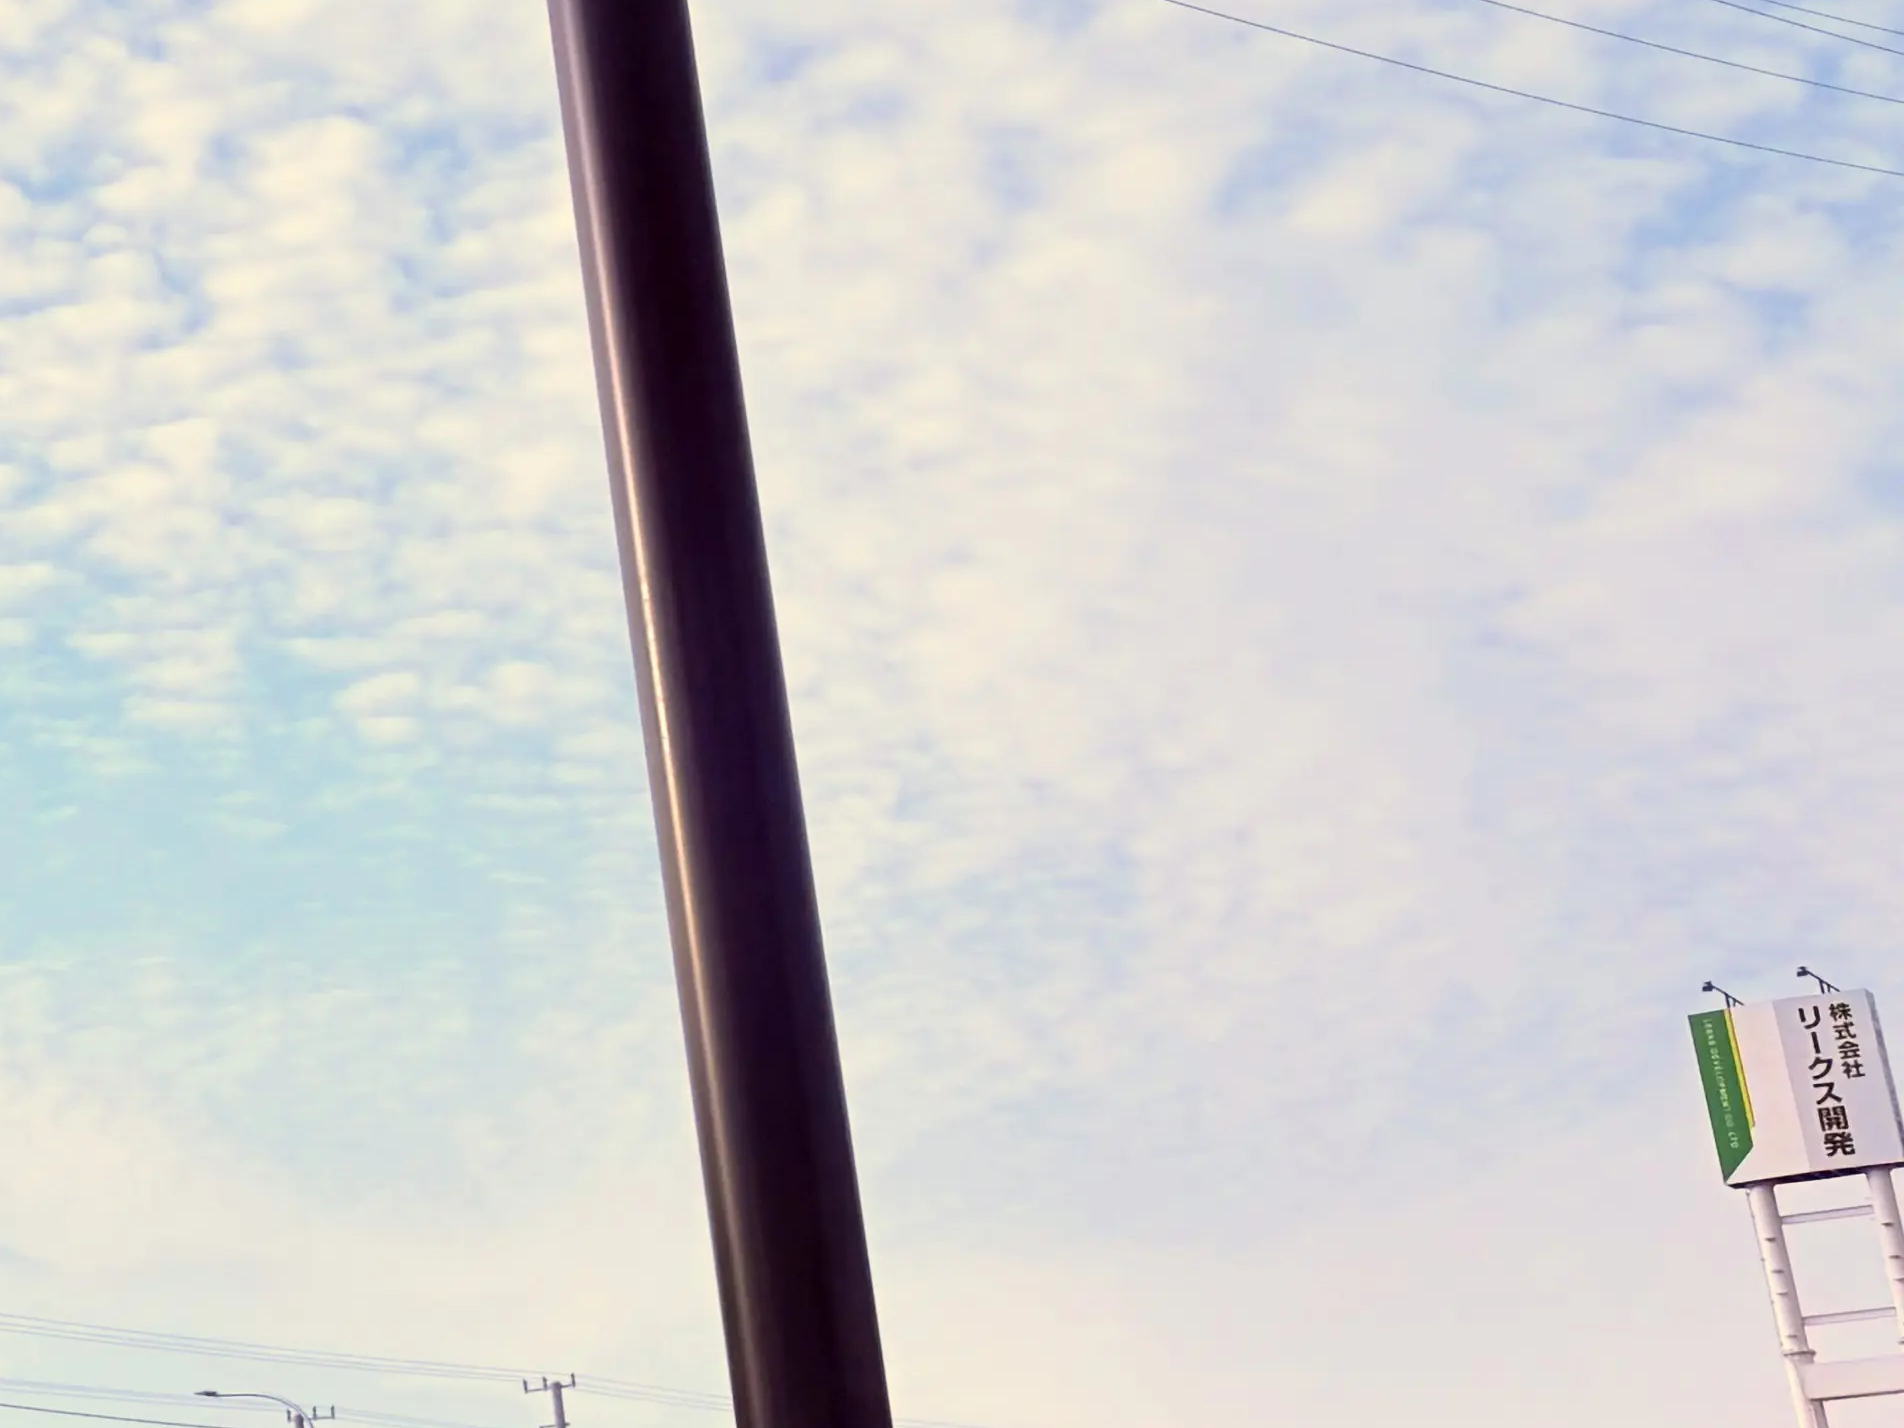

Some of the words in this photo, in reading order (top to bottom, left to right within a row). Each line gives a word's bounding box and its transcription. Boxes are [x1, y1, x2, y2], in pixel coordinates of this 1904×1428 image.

[1798, 1004, 1856, 1158] リークス開発
[1828, 1002, 1866, 1080] 株式会社
